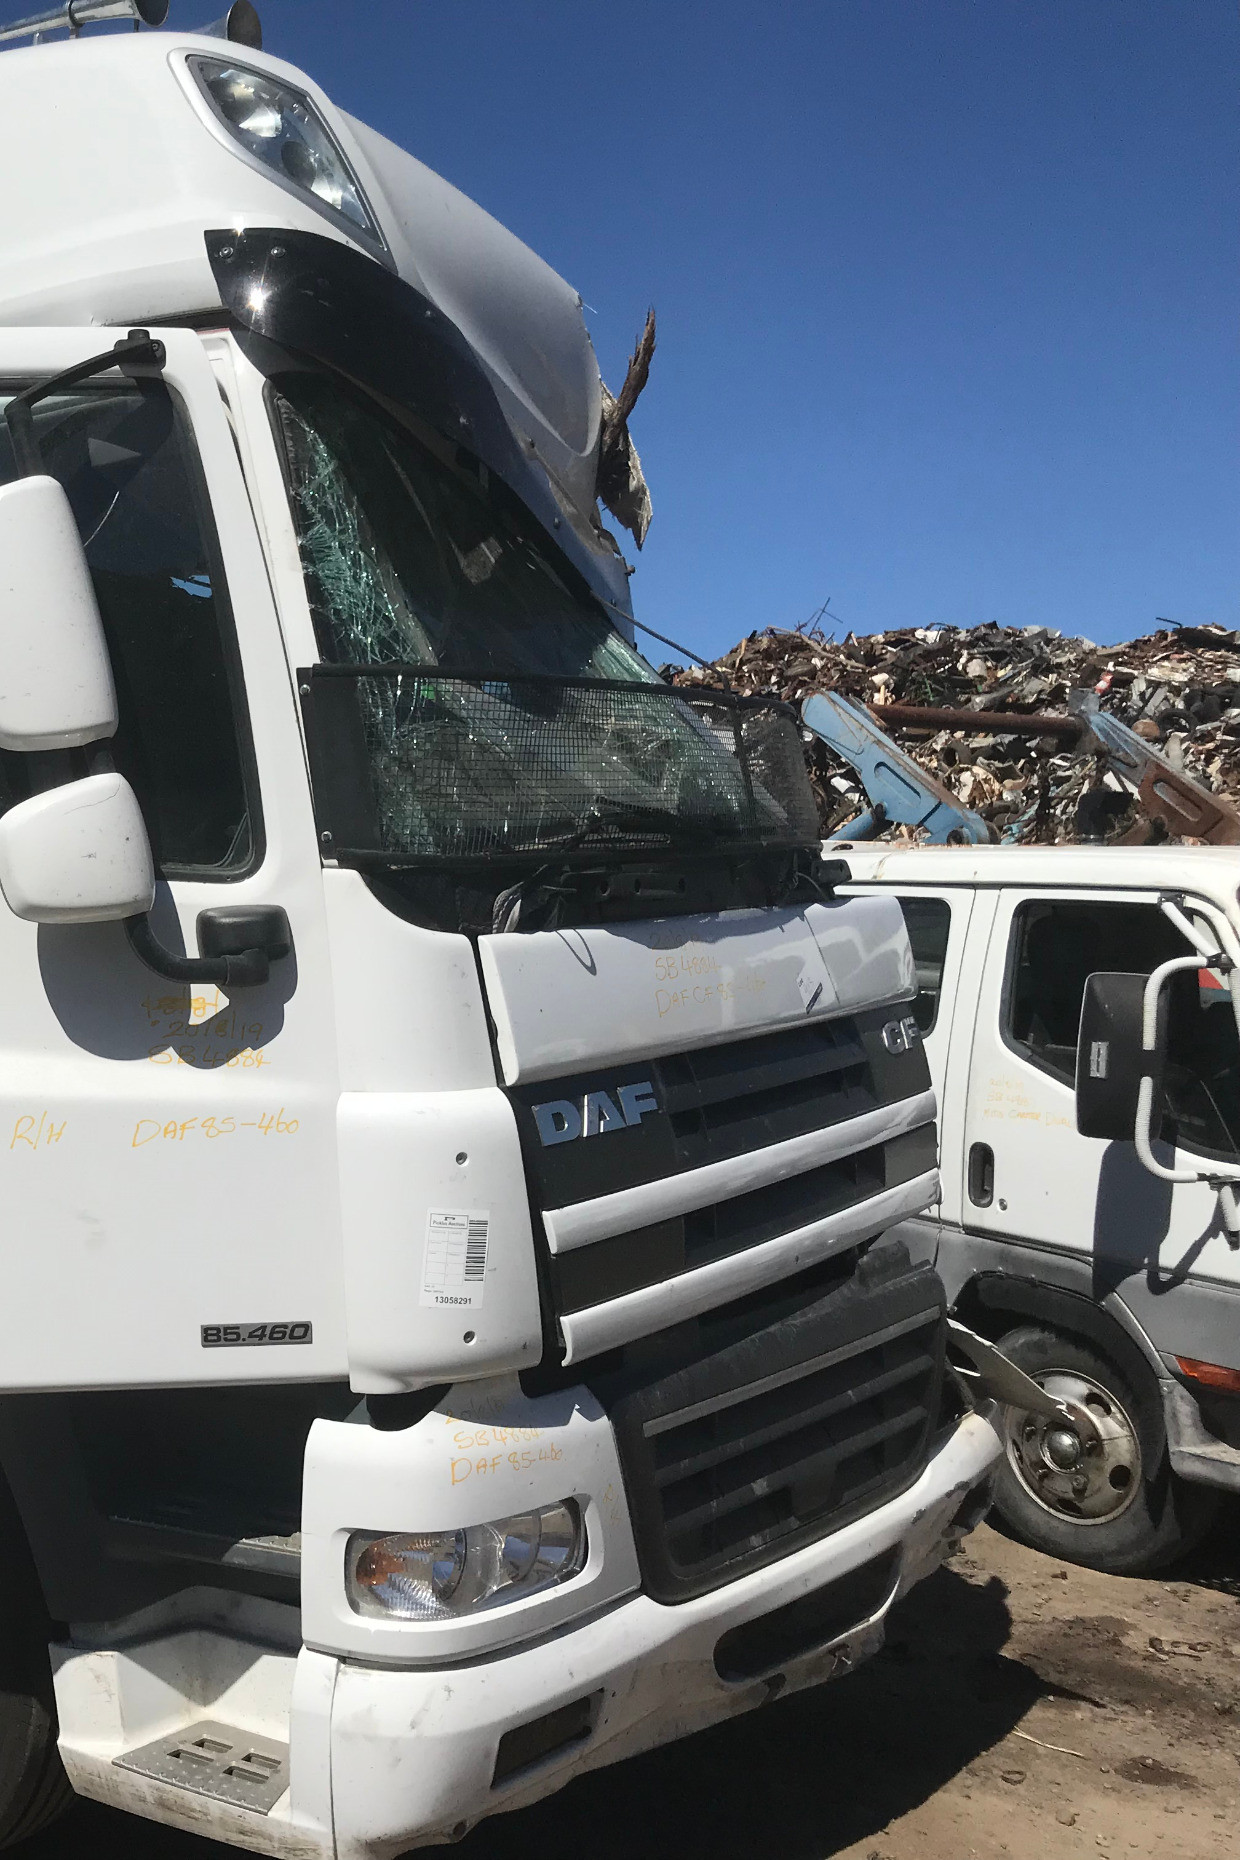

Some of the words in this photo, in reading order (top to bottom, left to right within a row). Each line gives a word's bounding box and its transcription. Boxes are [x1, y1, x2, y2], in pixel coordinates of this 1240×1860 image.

[882, 1016, 920, 1055] CF
[10, 1110, 67, 1149] R/H
[531, 1081, 659, 1147] DAF
[434, 1296, 472, 1305] 13058291
[203, 1323, 310, 1343] 85.460
